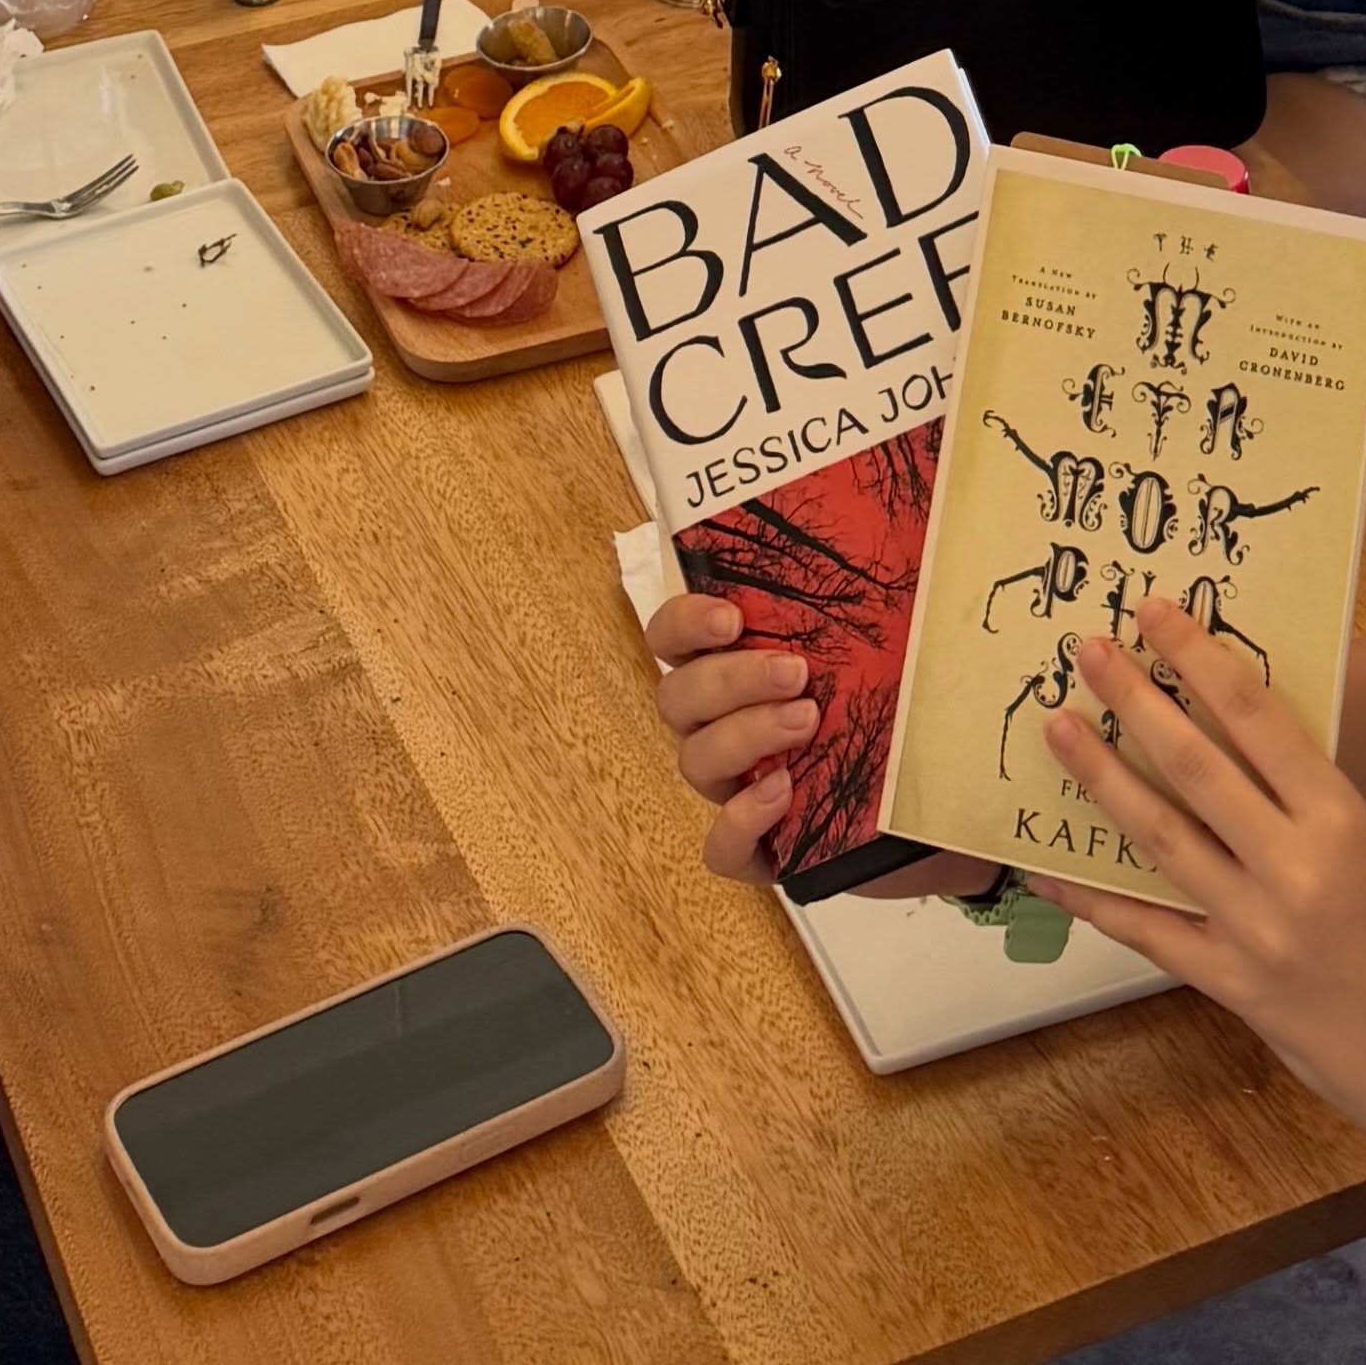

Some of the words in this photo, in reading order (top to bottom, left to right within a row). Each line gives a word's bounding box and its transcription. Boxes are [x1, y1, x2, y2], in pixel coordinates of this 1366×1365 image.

[784, 146, 802, 160] a
[804, 160, 864, 220] novel
[592, 85, 971, 342] BAD
[1153, 233, 1219, 261] THE
[1025, 296, 1076, 316] SUSAN
[1001, 309, 1096, 340] BERNOFSKY
[1269, 347, 1319, 366] DAVID
[1239, 360, 1346, 391] CRONENBERG
[685, 407, 869, 509] JESSICA
[1014, 807, 1158, 874] KAFK
